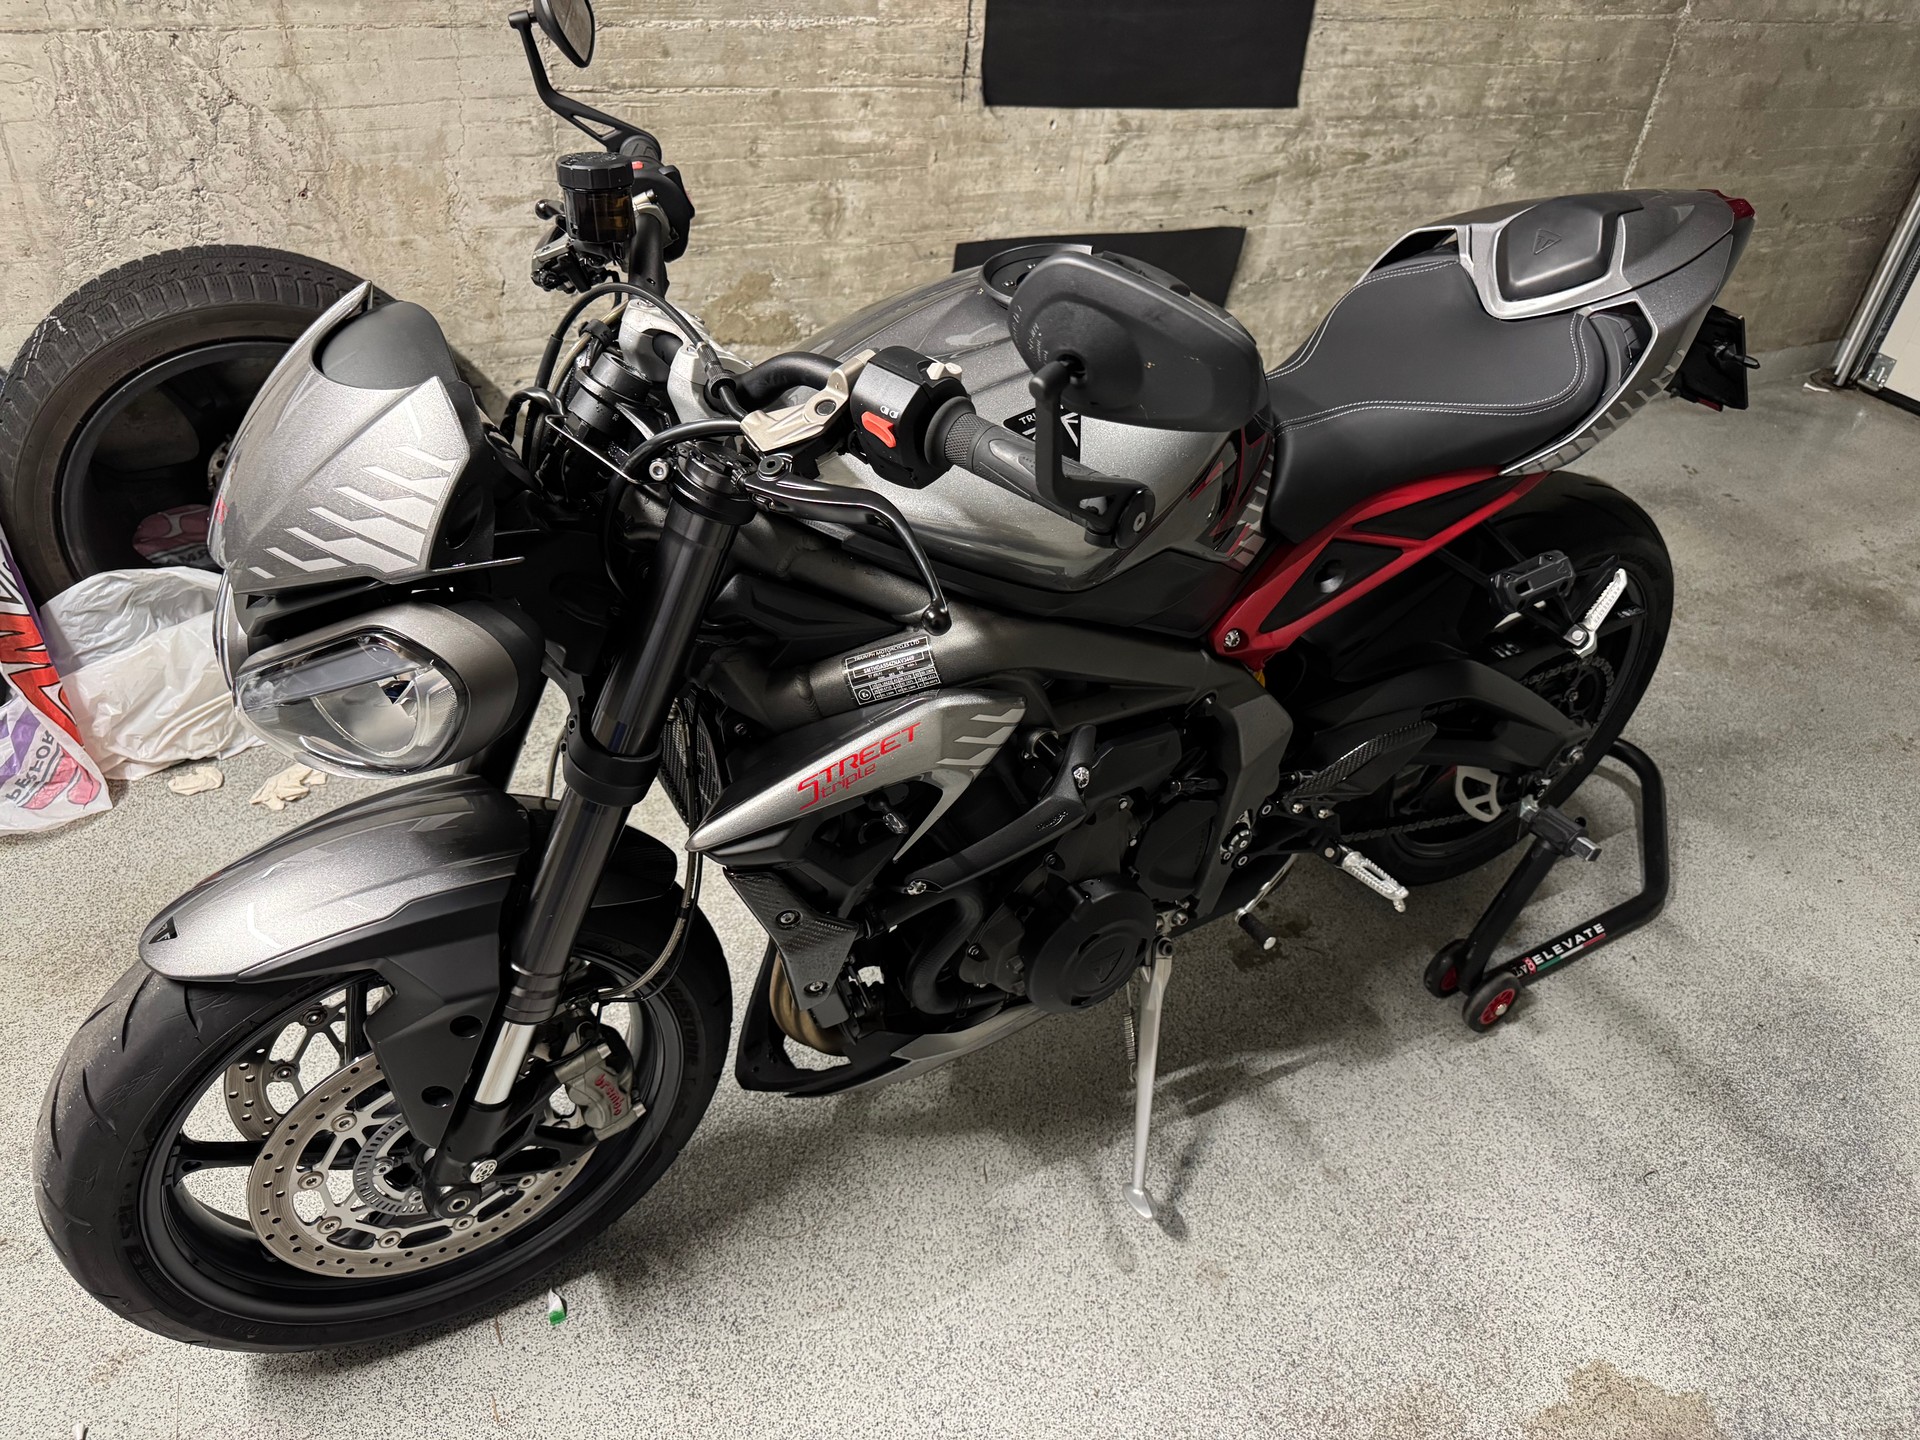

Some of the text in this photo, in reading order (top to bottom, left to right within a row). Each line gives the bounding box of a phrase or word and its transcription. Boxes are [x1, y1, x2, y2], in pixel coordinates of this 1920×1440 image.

[797, 722, 921, 810] STREET
[820, 763, 876, 798] triple
[1531, 923, 1605, 966] ELEVATE
[595, 1073, 624, 1116] brembo
